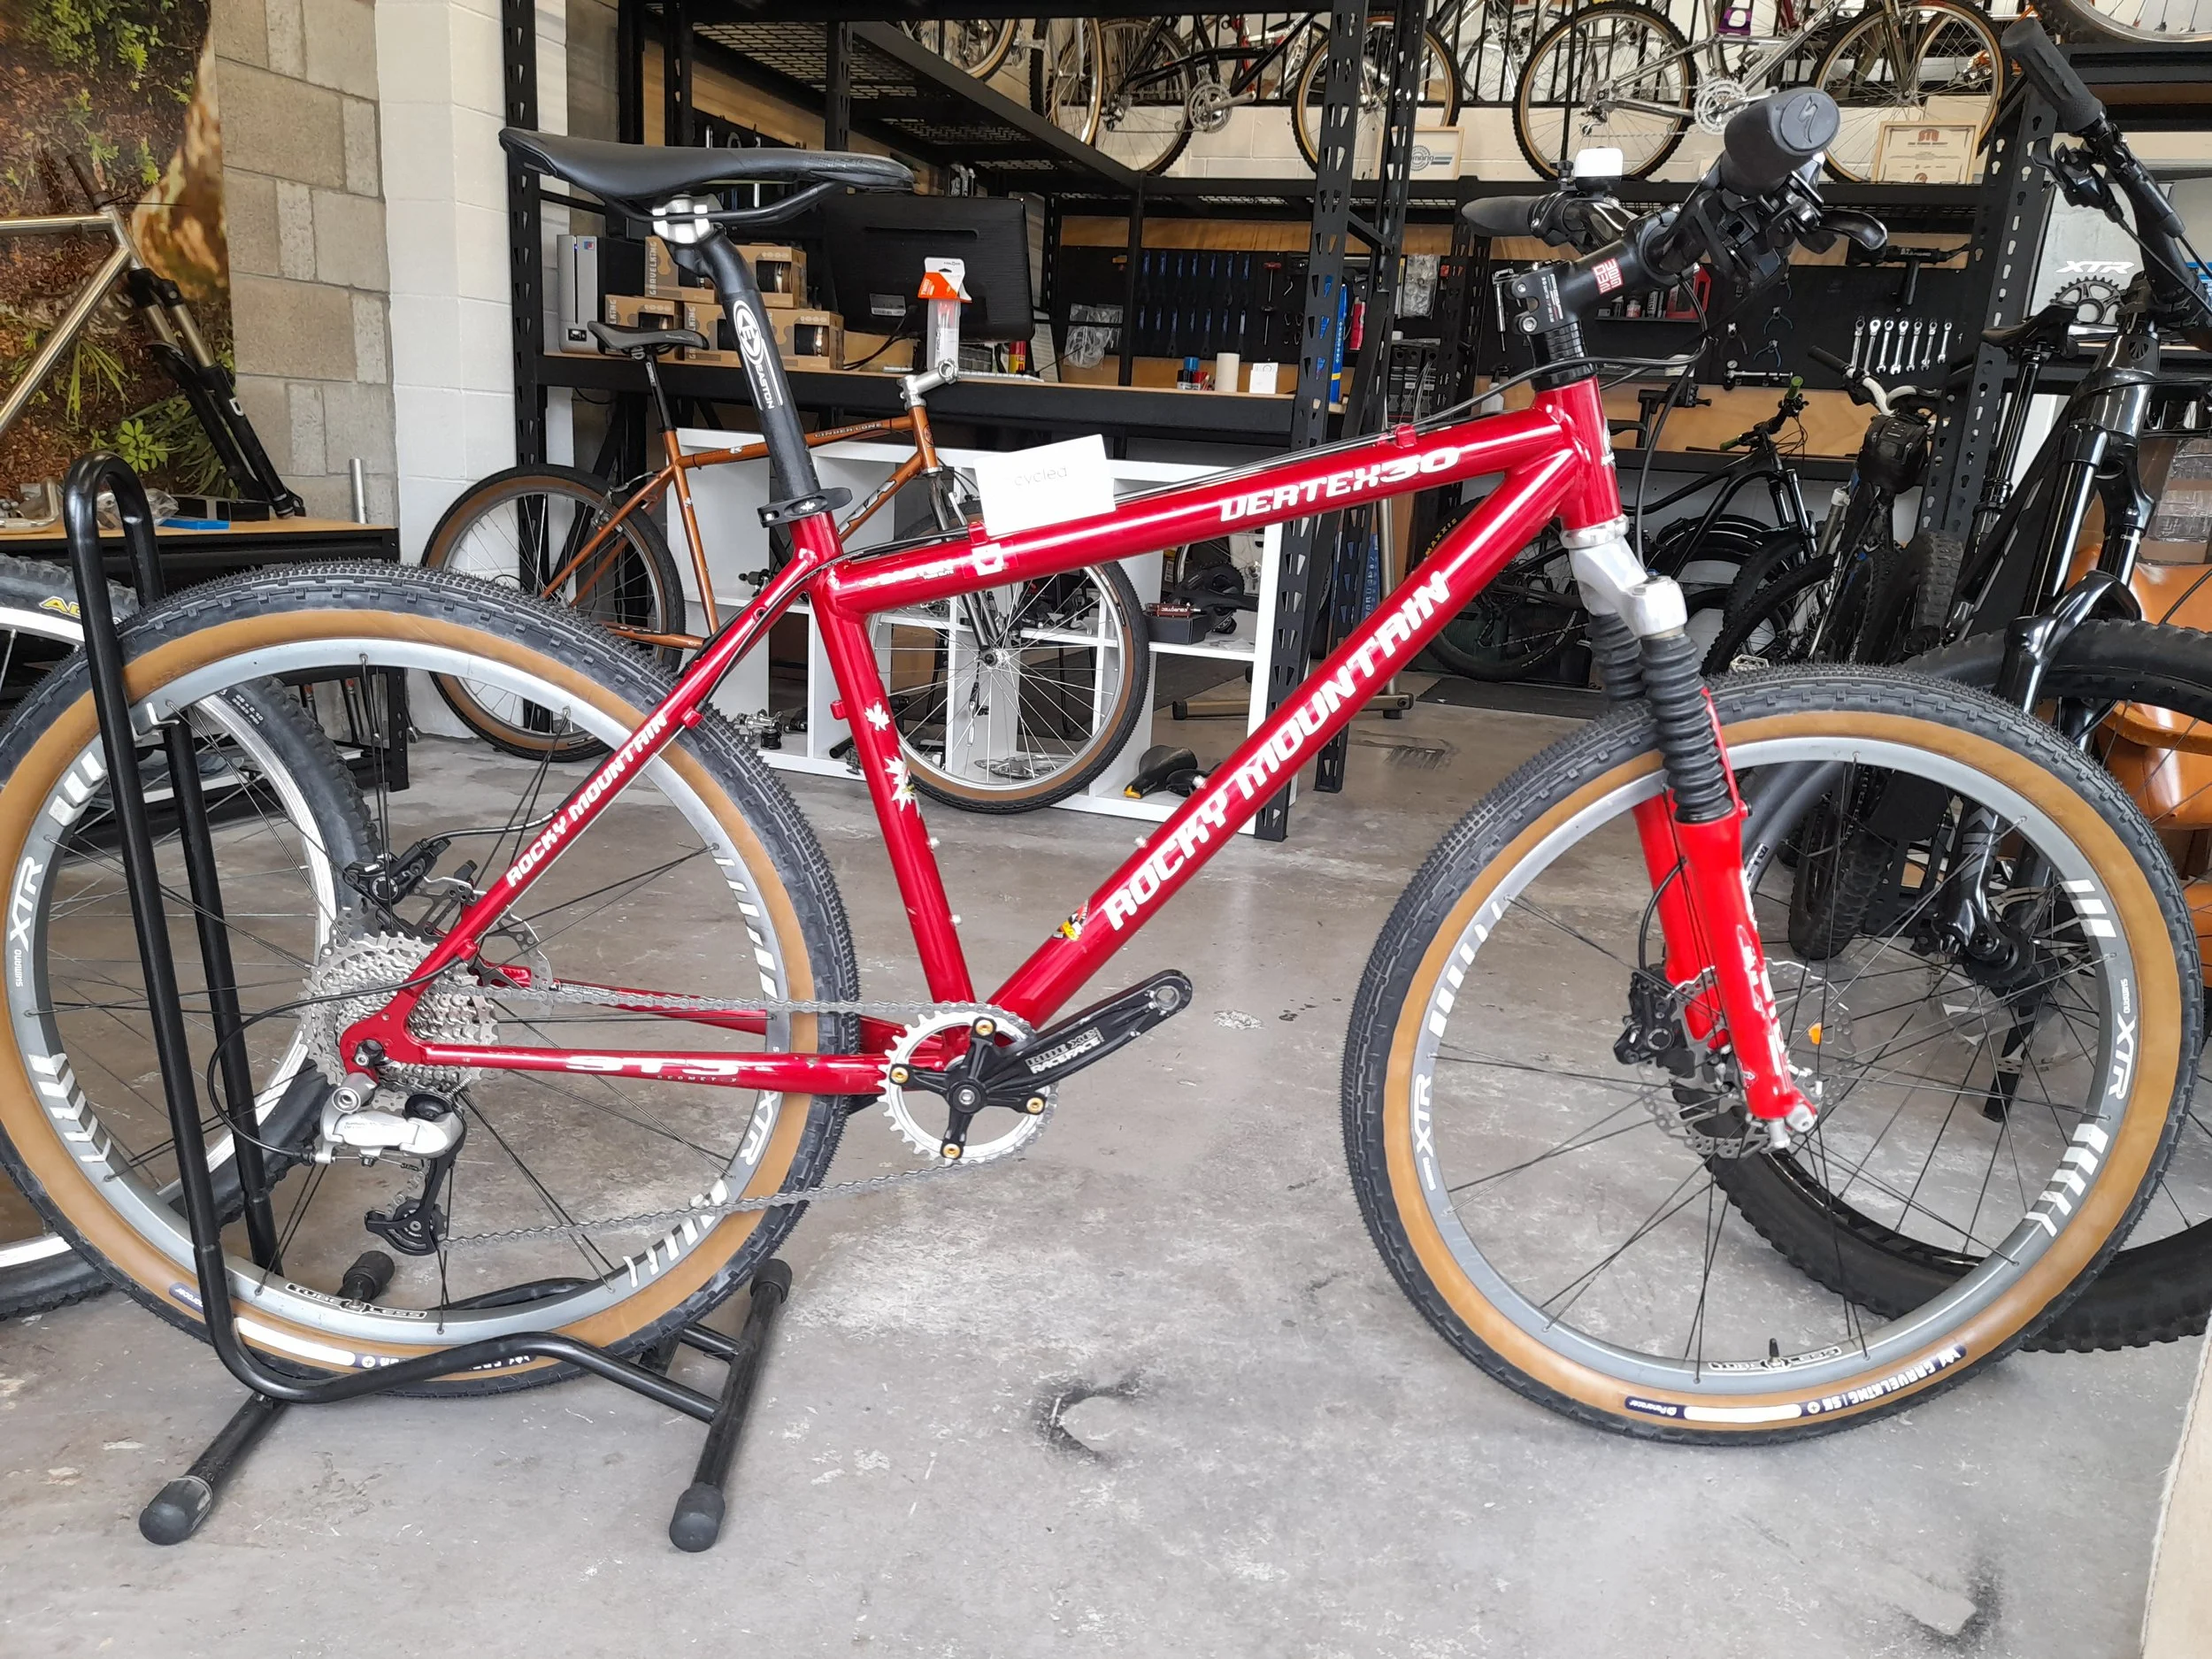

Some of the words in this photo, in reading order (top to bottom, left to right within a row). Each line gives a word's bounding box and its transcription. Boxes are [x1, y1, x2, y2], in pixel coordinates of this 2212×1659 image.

[2055, 260, 2135, 274] XTR
[756, 364, 774, 409] EASTON
[814, 426, 853, 438] CINDER
[855, 422, 883, 433] CONE
[1425, 518, 1457, 557] MAXXIS
[1102, 787, 1232, 932] ROCKY
[1232, 570, 1452, 802] MOUNTAIN
[505, 815, 567, 887] ROCKY
[567, 710, 668, 822] MOUNTAIN
[10, 856, 43, 952] XTR
[14, 949, 24, 987] SHIMANO
[1029, 1037, 1101, 1074] RACEFACE
[2108, 1012, 2137, 1100] XTR
[740, 1090, 778, 1165] XTR
[1414, 1073, 1433, 1157] XTR
[1629, 1398, 1668, 1414] Panaracer
[1848, 1361, 1936, 1406] GRAVELKING
